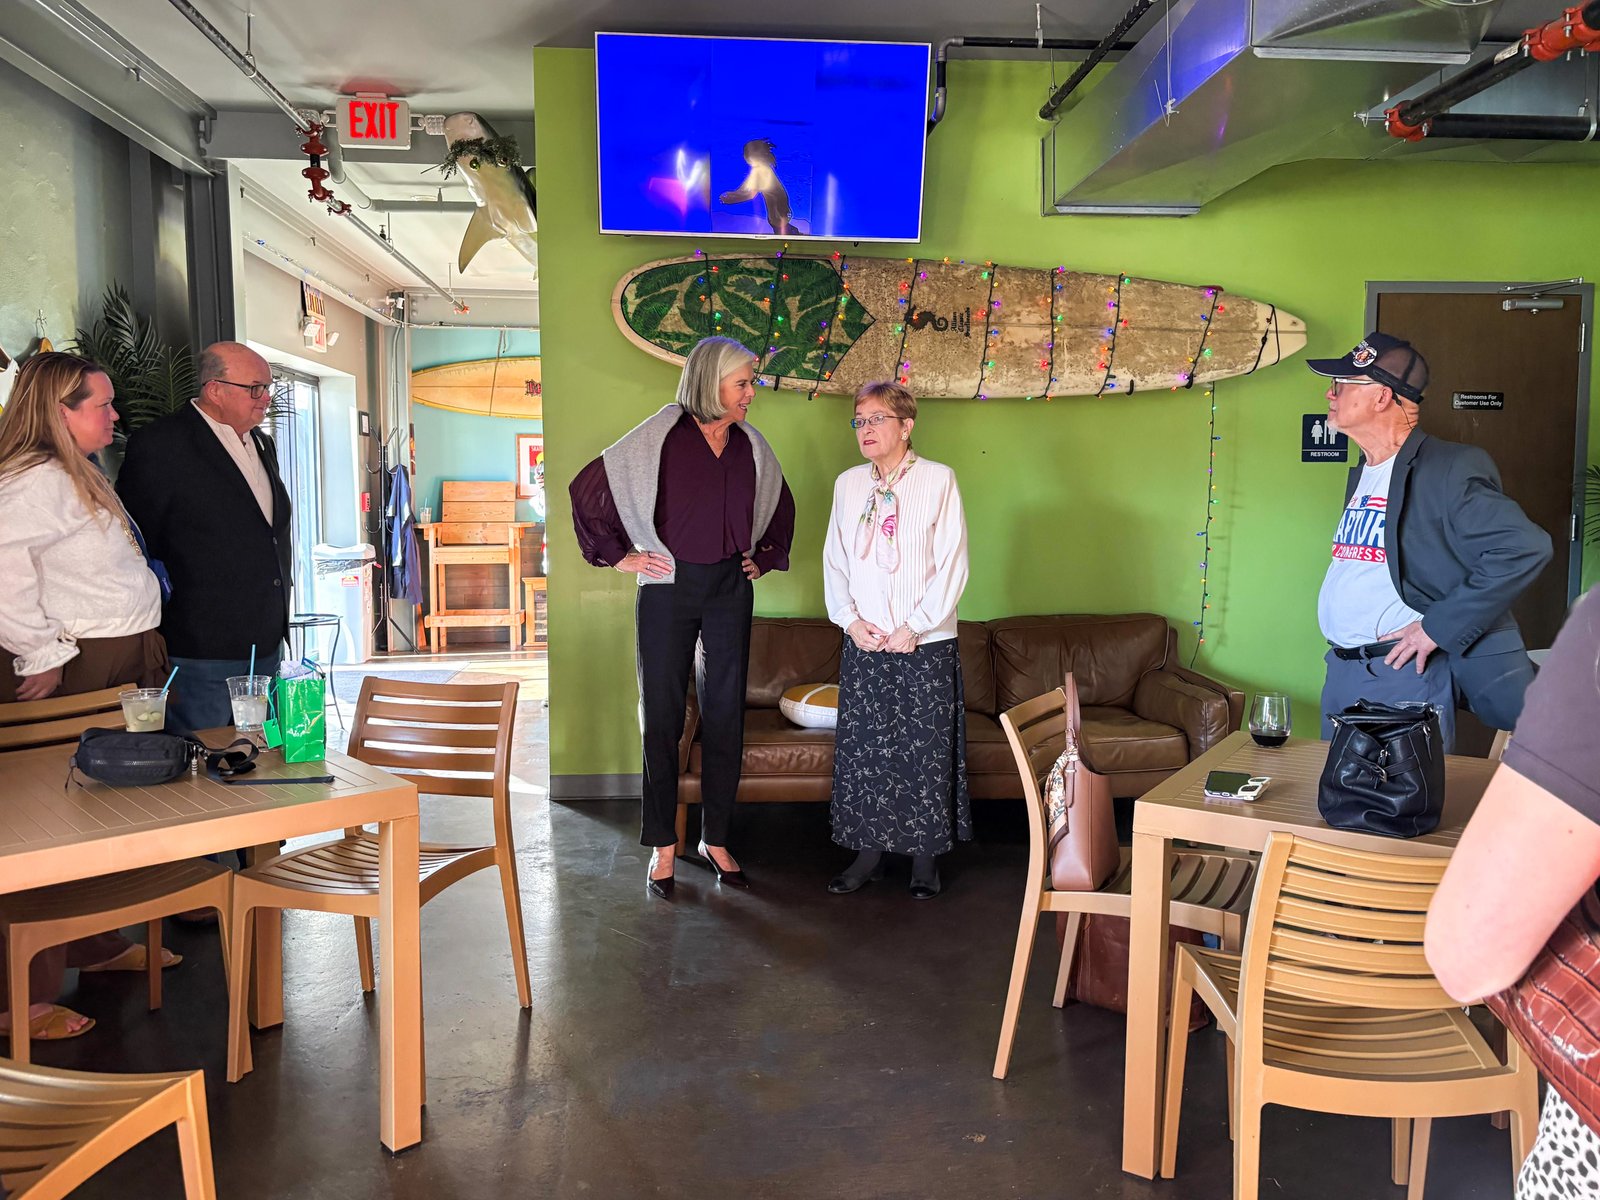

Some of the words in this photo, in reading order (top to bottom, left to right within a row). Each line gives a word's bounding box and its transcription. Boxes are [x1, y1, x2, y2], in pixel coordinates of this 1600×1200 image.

[349, 101, 399, 139] EXIT
[1333, 509, 1386, 548] APTUR
[1335, 545, 1385, 562] CONGRESS
